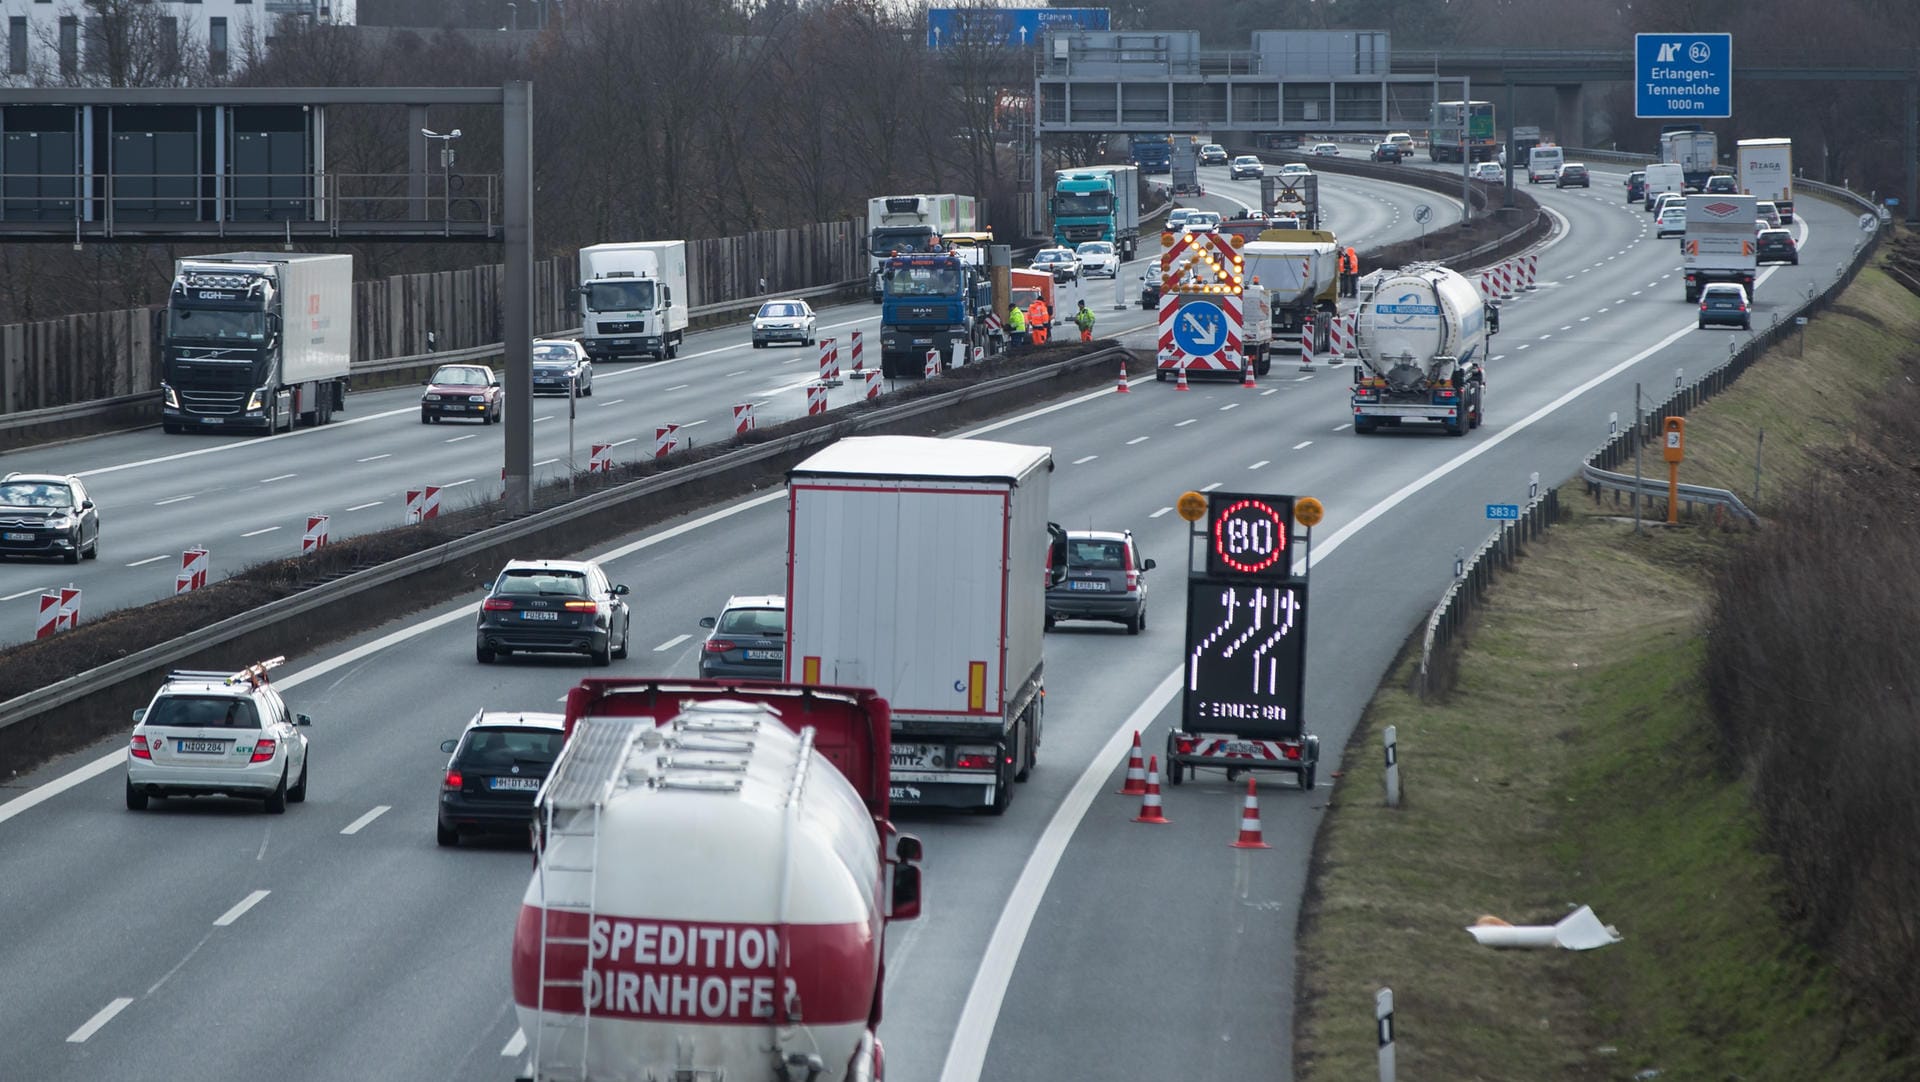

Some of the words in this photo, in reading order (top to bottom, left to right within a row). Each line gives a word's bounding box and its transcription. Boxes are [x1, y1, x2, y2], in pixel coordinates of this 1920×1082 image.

[1692, 47, 1708, 59] 84
[1651, 67, 1716, 82] Erlangen-
[1646, 83, 1721, 96] Tennenlohe
[1667, 99, 1692, 110] 1000
[1693, 101, 1705, 110] m
[199, 291, 222, 300] GGH
[1227, 518, 1272, 554] 80
[591, 919, 791, 970] SPEDITION
